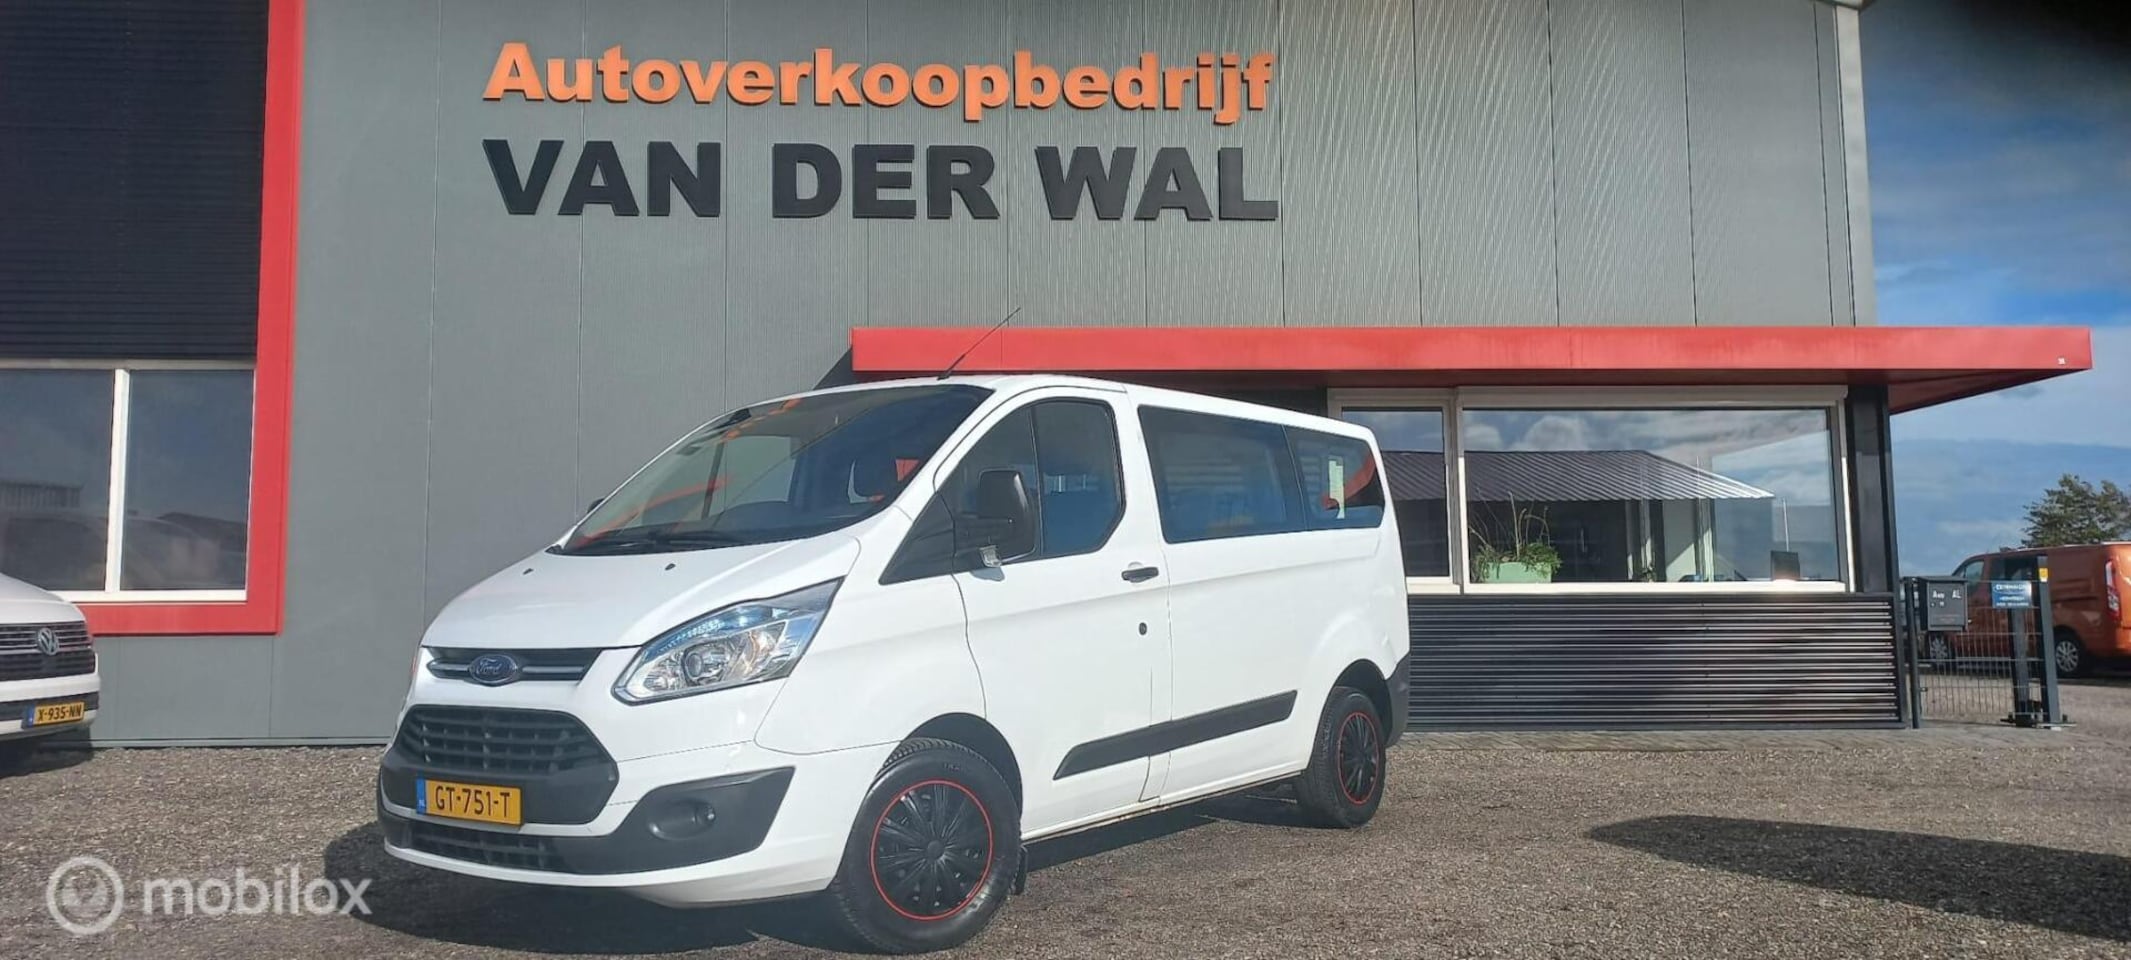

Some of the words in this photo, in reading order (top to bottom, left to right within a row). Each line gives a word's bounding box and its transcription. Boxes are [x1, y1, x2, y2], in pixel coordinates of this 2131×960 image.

[482, 42, 1274, 124] Autoverkoopbedrijf
[482, 139, 721, 218] VAN
[772, 143, 1001, 220] DER
[1034, 146, 1279, 222] WAL
[37, 704, 82, 721] X-935-NN
[435, 785, 511, 818] GT-751-T
